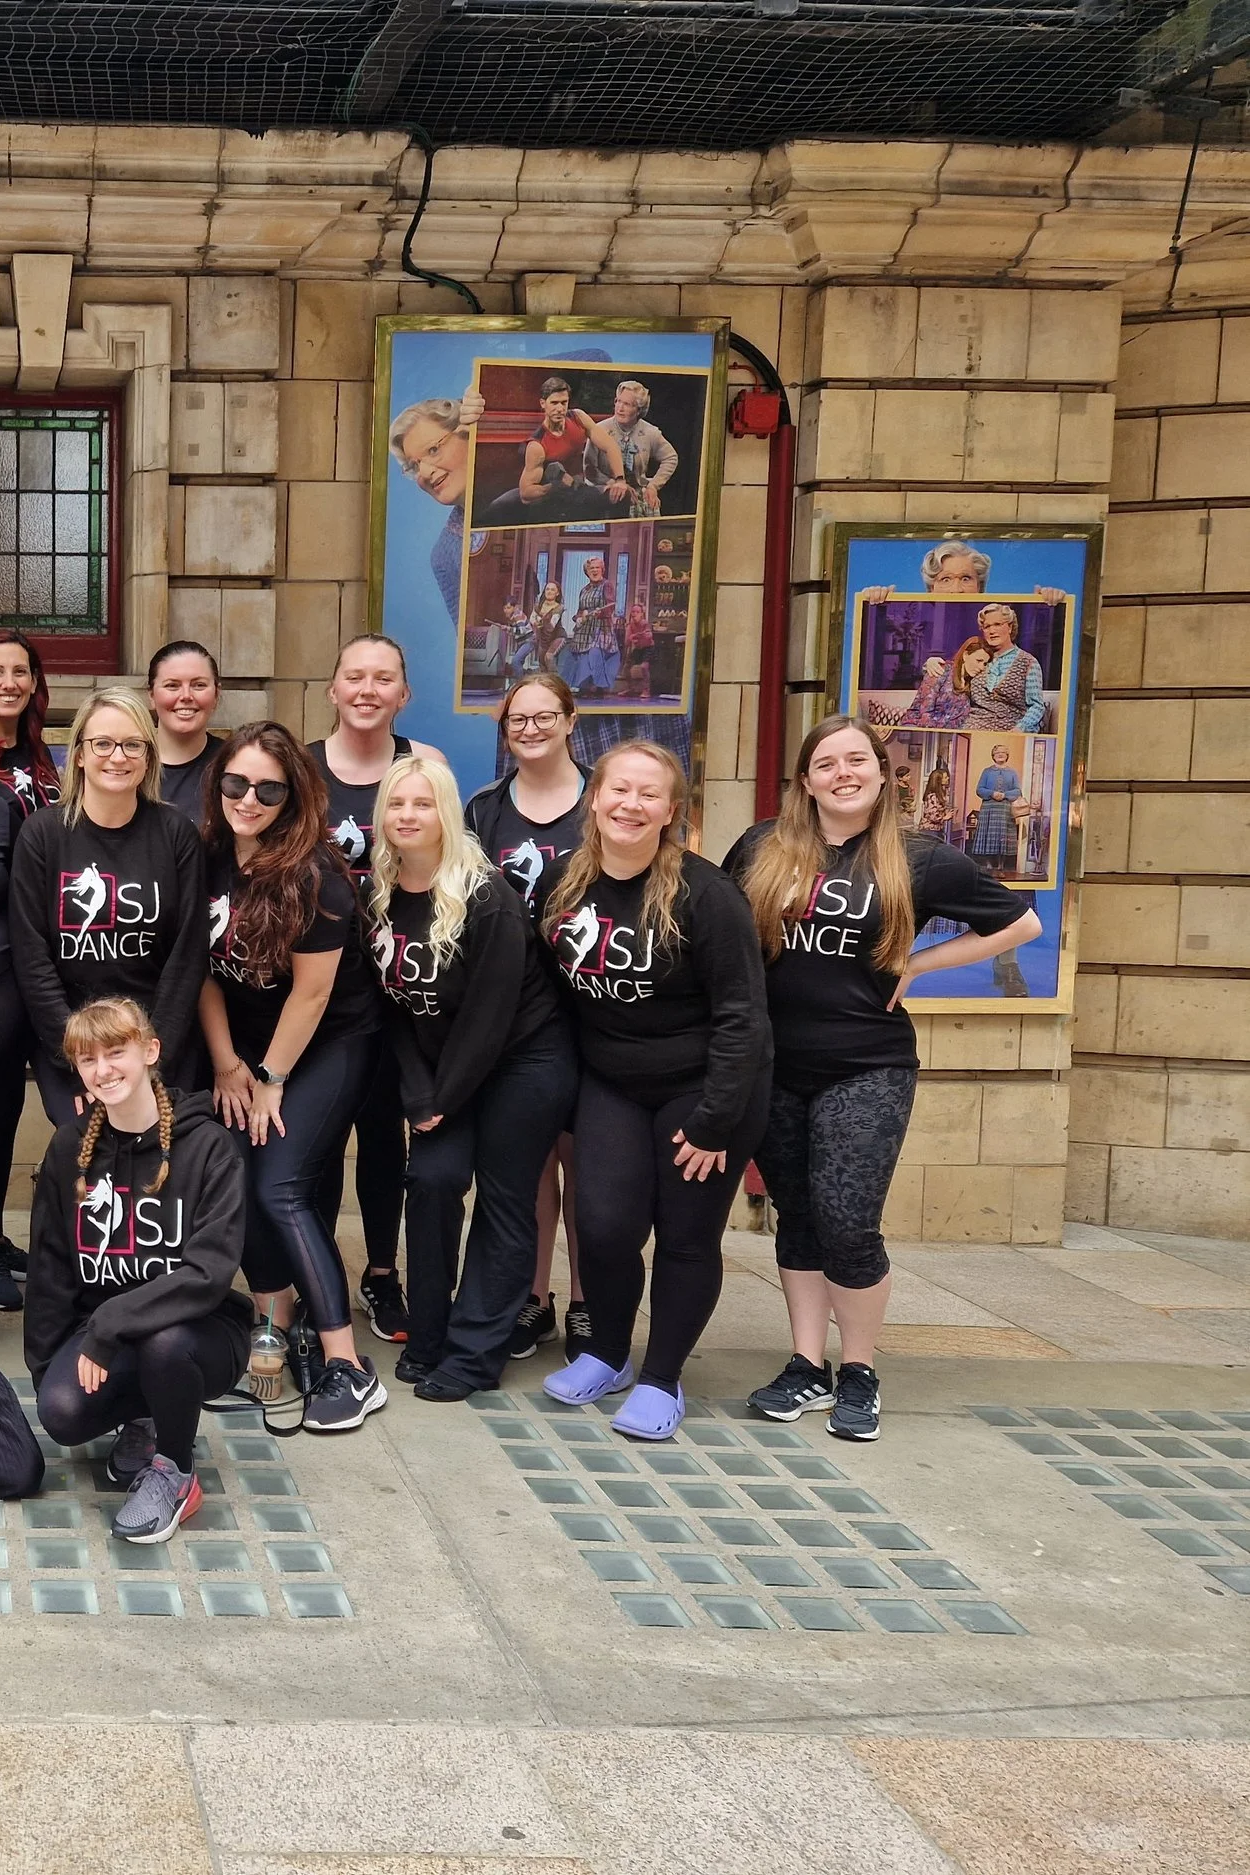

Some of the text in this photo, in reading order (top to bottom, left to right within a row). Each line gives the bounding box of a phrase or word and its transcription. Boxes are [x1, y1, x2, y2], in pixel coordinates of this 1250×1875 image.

[116, 881, 160, 924] SJ
[815, 878, 875, 920] SJ
[60, 931, 156, 961] DANCE
[605, 926, 655, 972] SJ
[135, 1197, 183, 1248] SJ
